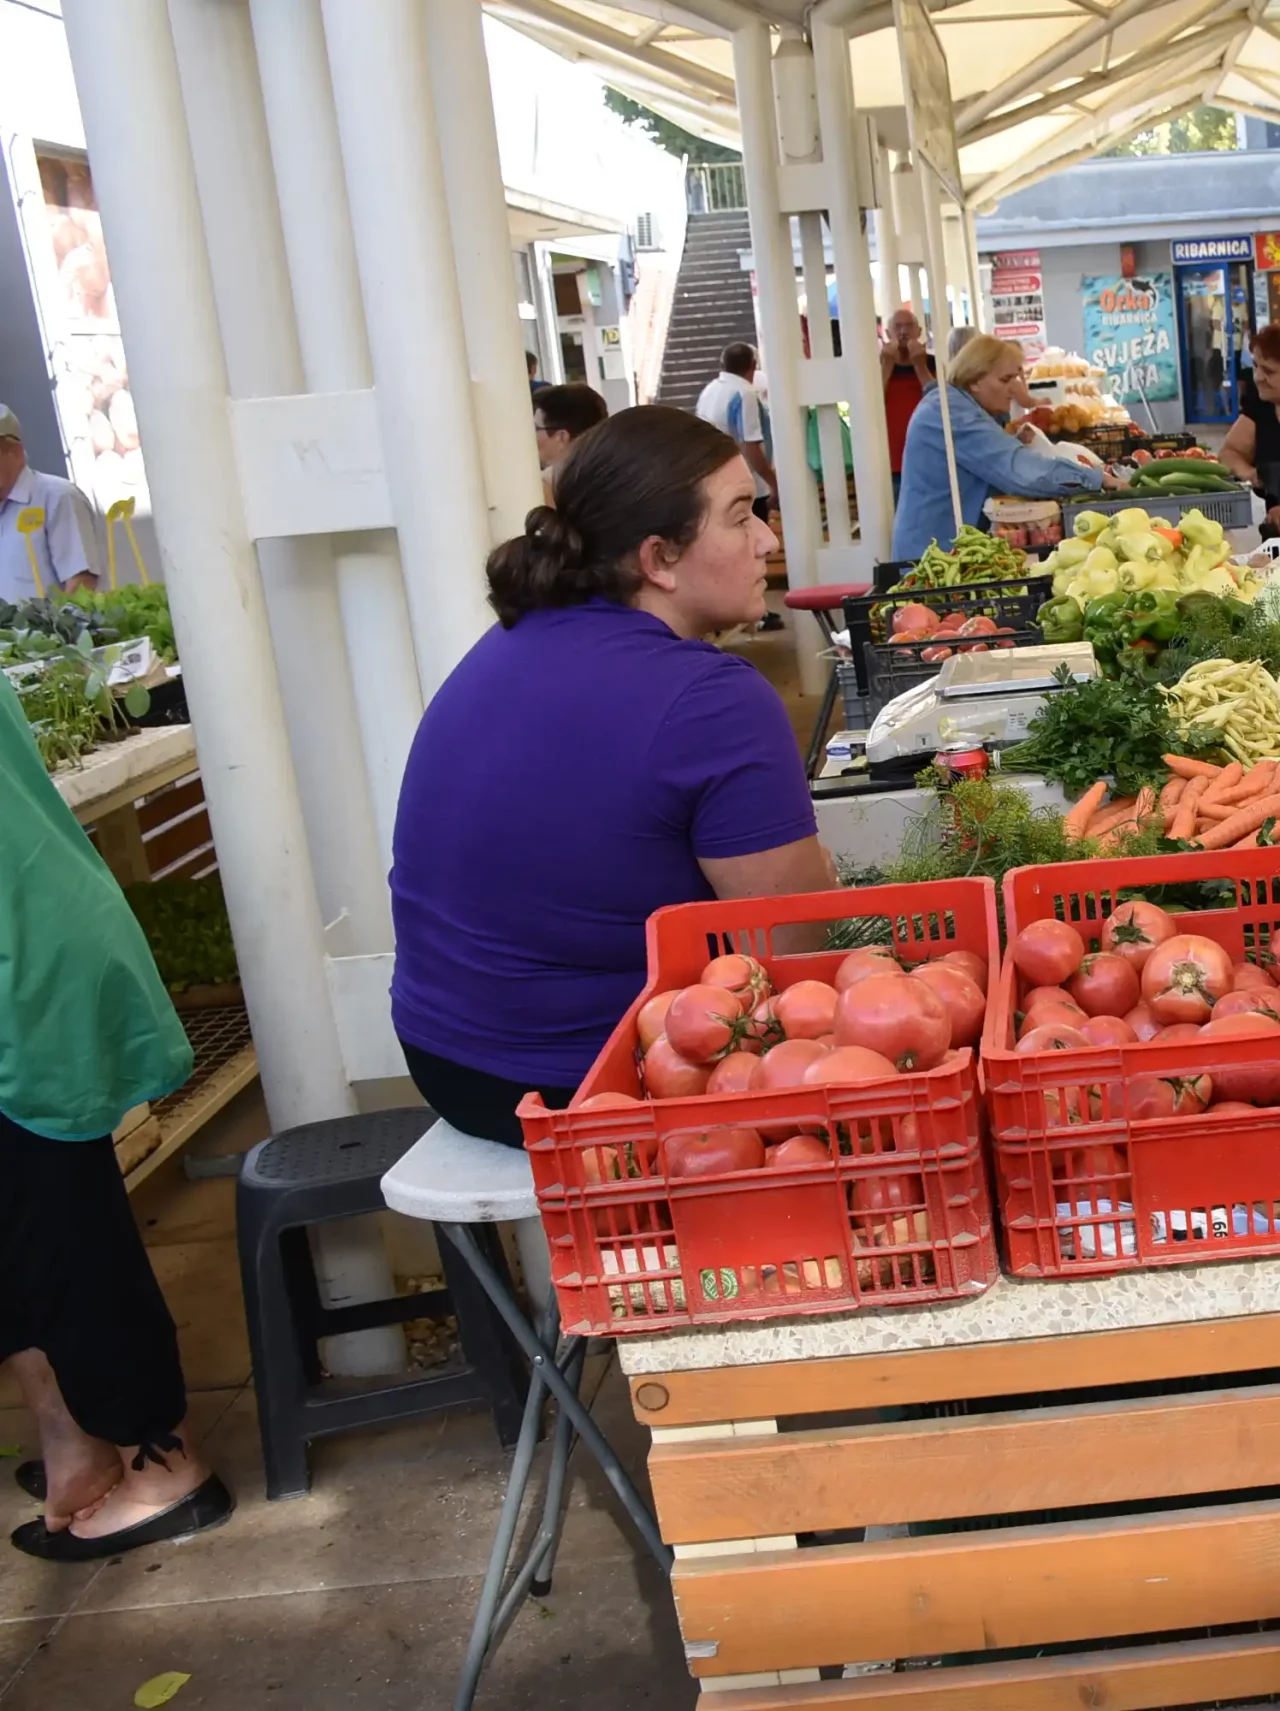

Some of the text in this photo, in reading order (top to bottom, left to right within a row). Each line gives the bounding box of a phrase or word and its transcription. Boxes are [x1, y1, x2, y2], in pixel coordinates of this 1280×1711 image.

[1175, 240, 1249, 259] RIBARNICA
[1100, 287, 1150, 313] Orka
[1102, 312, 1157, 325] RIBARNICA
[1092, 327, 1170, 368] SVJEŽA
[1109, 363, 1158, 395] RIBA
